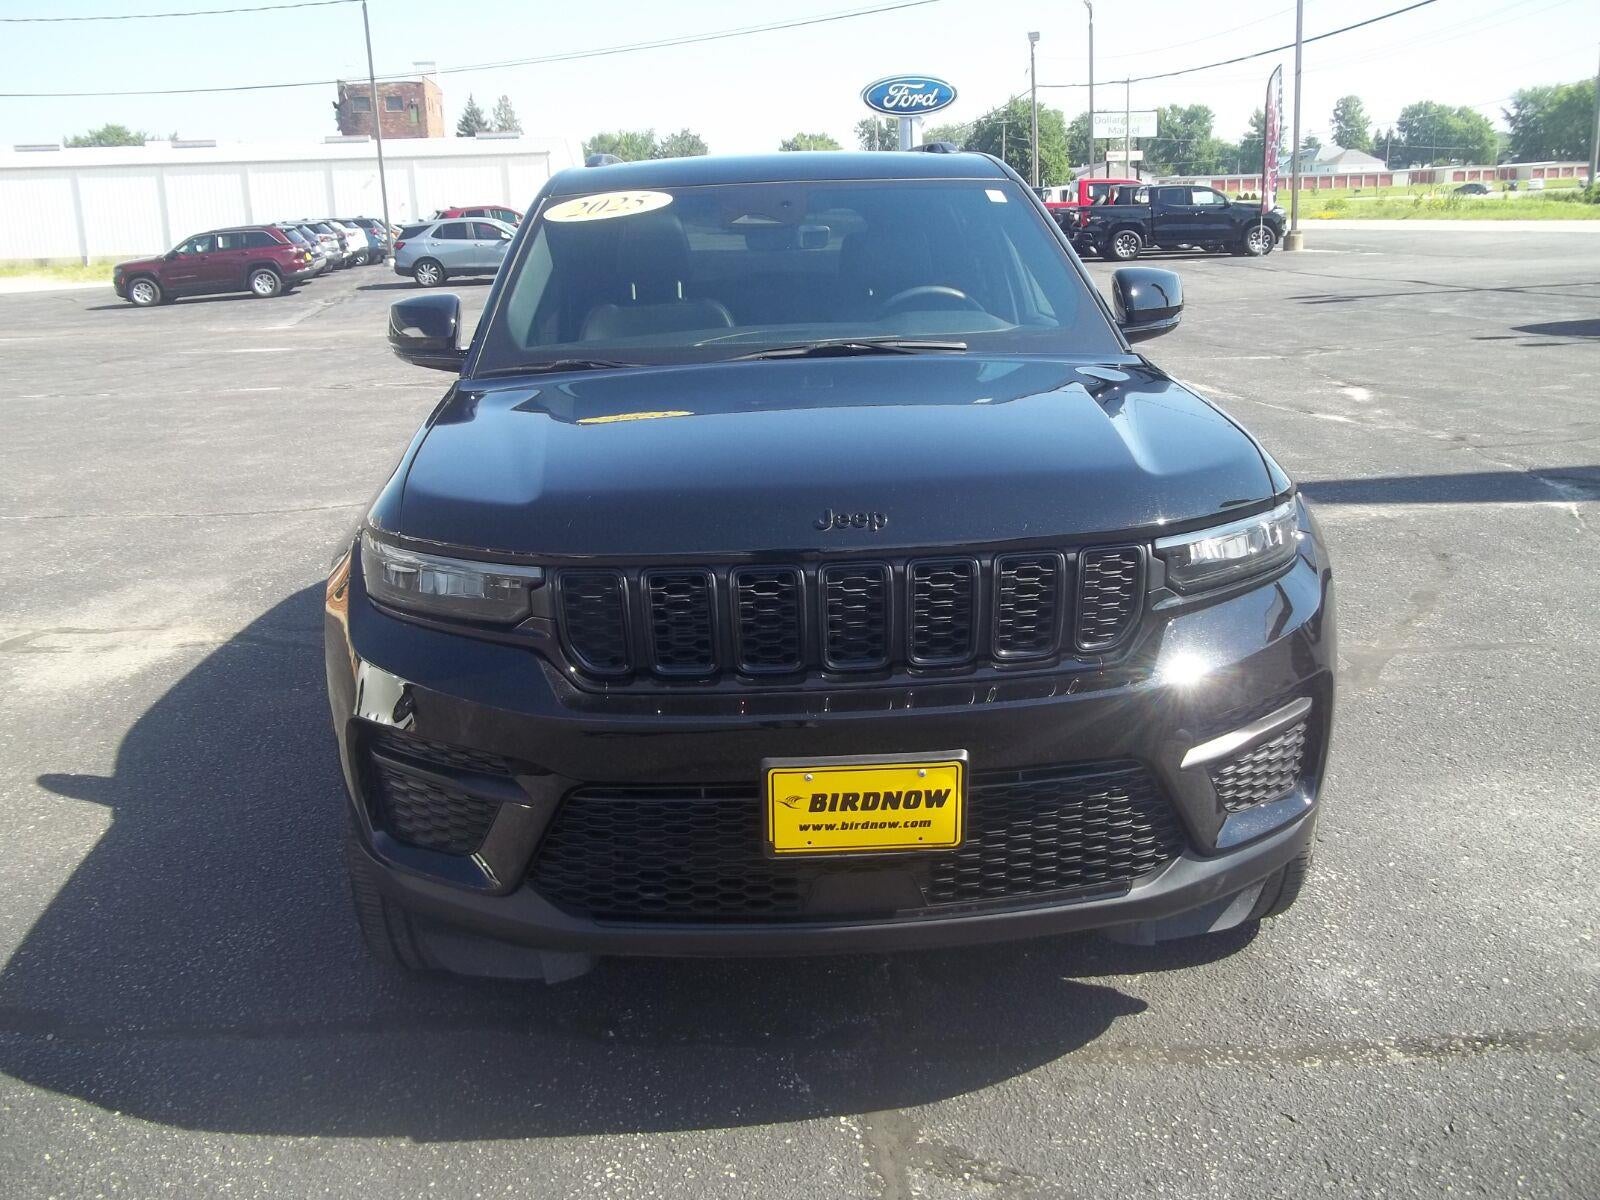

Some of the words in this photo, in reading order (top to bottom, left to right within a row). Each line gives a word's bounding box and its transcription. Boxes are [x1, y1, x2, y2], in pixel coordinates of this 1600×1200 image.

[883, 83, 939, 108] Ford
[1094, 115, 1120, 125] Dollar
[565, 194, 651, 218] 2025
[813, 508, 888, 533] Jeep
[808, 788, 951, 813] BIRDNOW
[798, 819, 931, 832] www.birdnow.com
